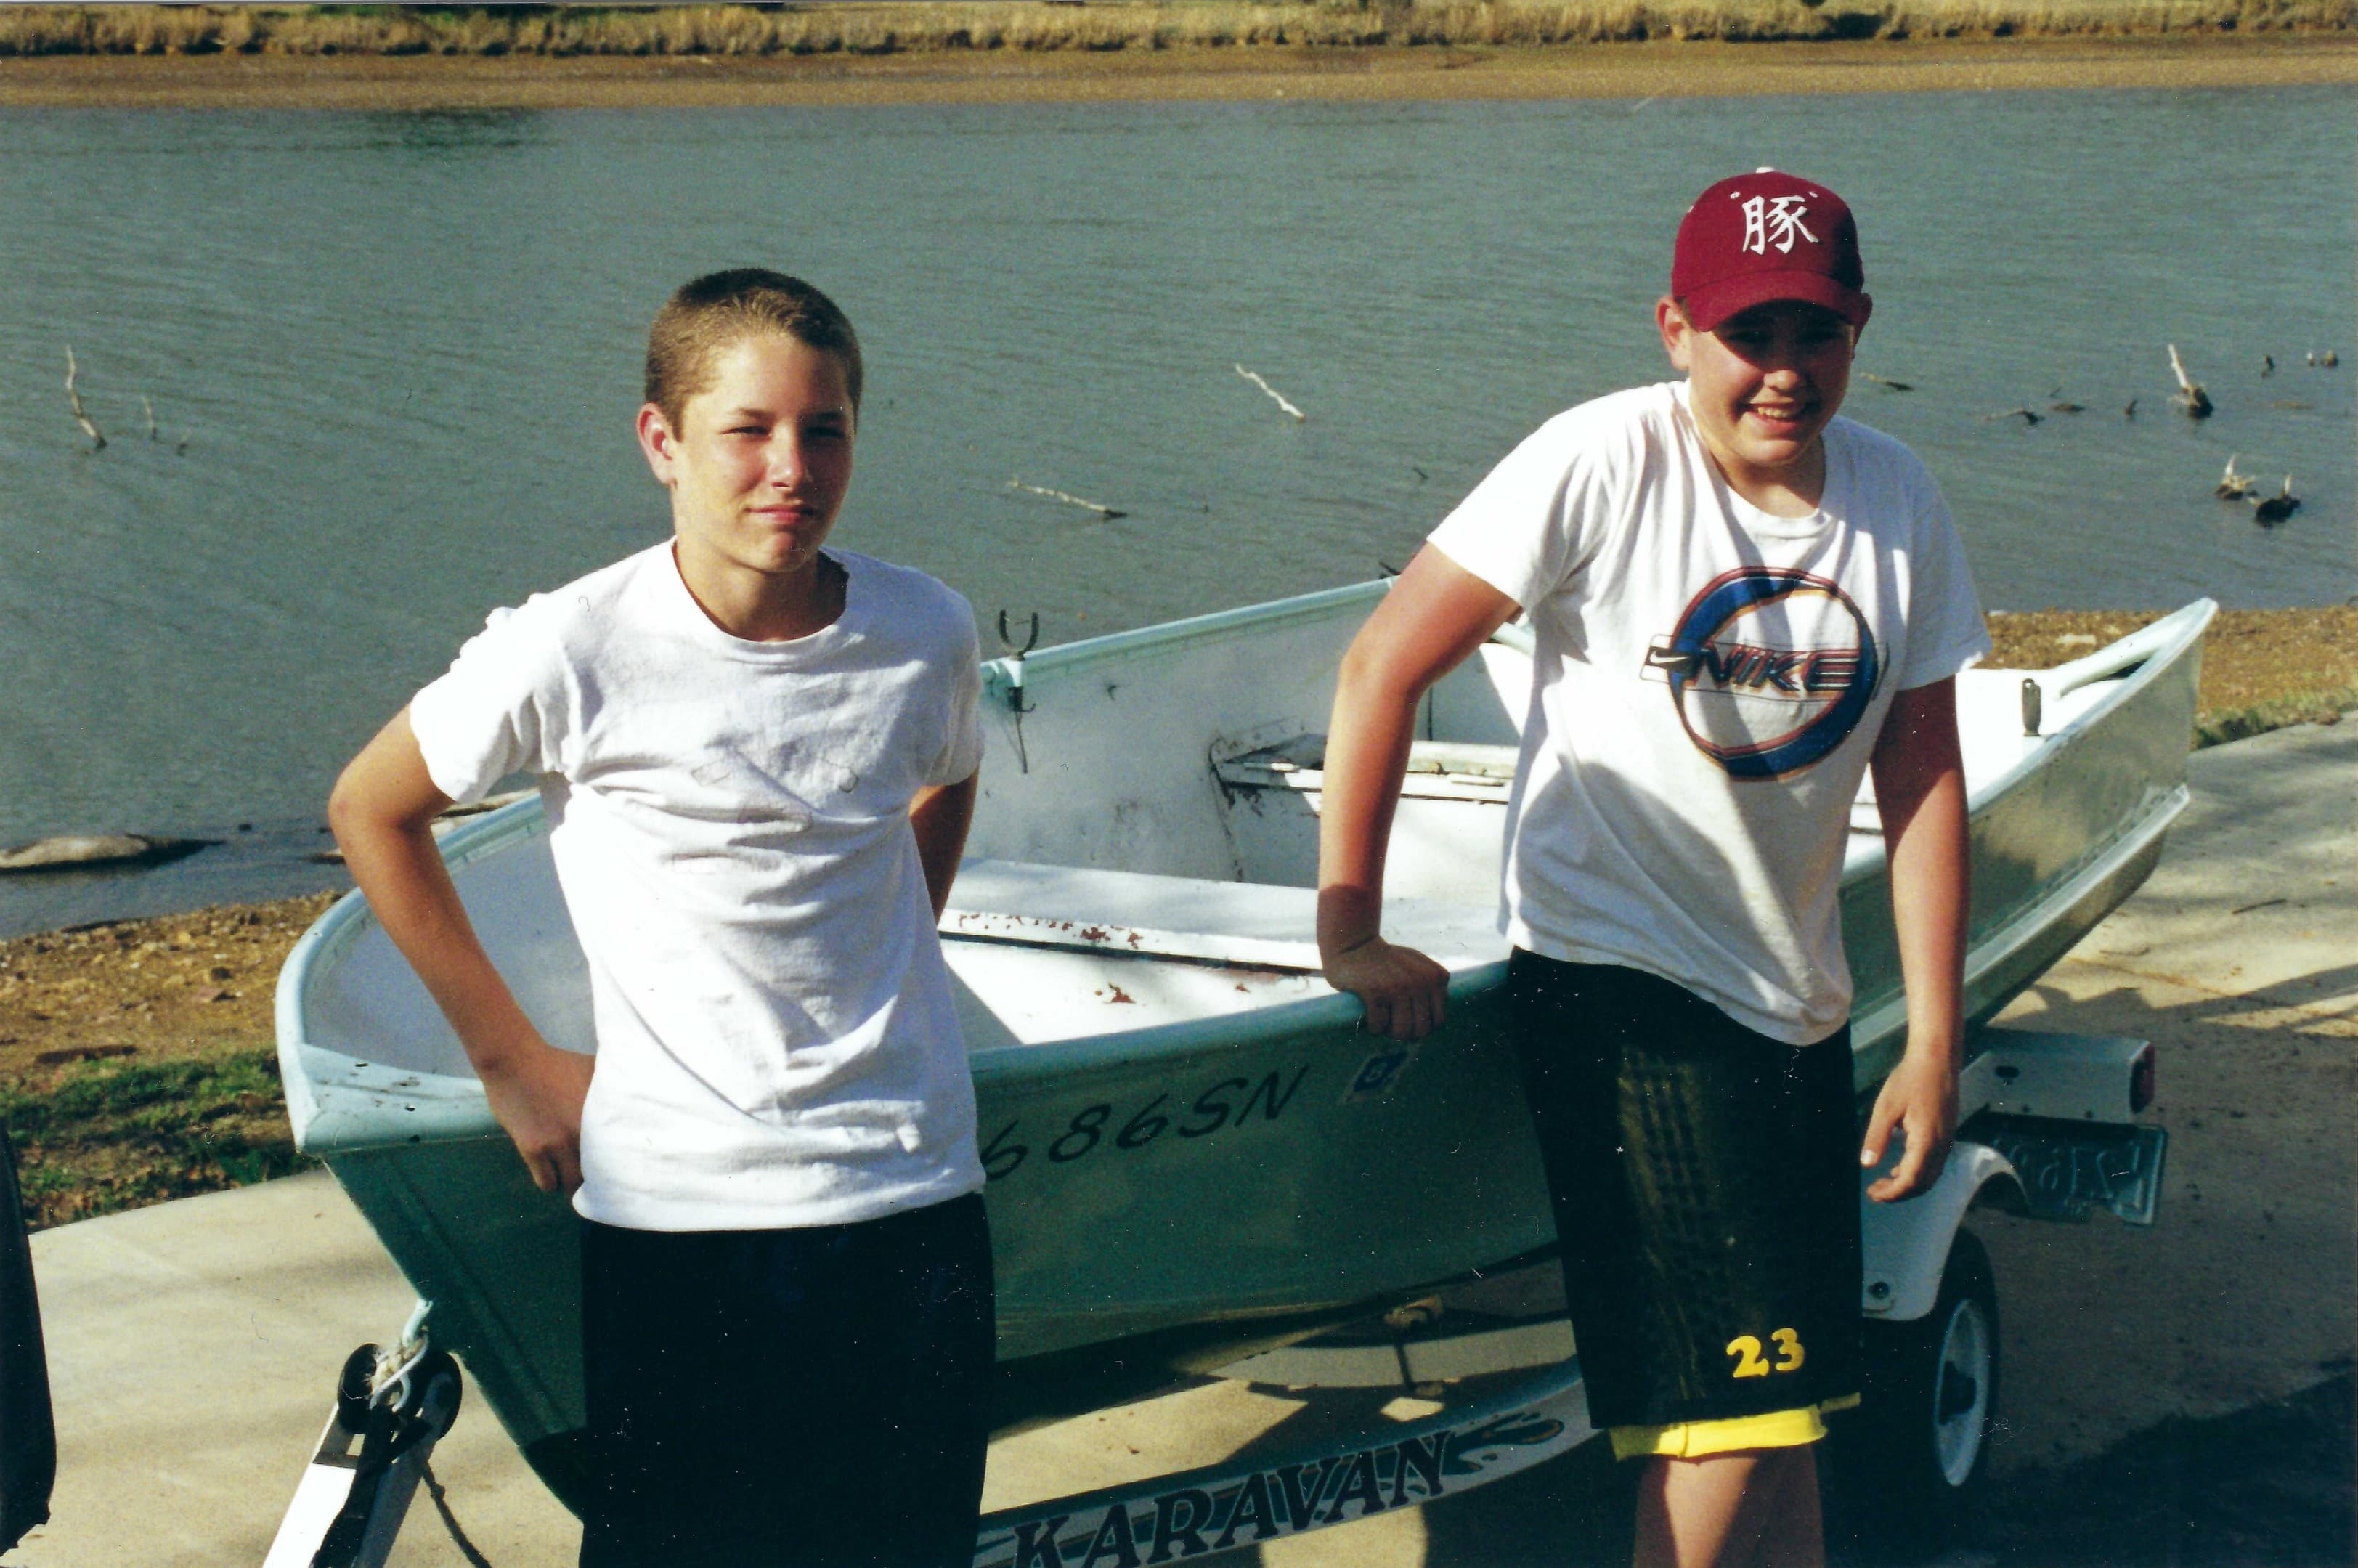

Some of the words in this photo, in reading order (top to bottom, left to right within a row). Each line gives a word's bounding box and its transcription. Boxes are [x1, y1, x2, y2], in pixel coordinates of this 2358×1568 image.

[1742, 195, 1819, 255] 豚
[1692, 640, 1860, 693] NIKE
[1726, 1328, 1805, 1378] 23
[1014, 1429, 1452, 1568] KARAVAN
